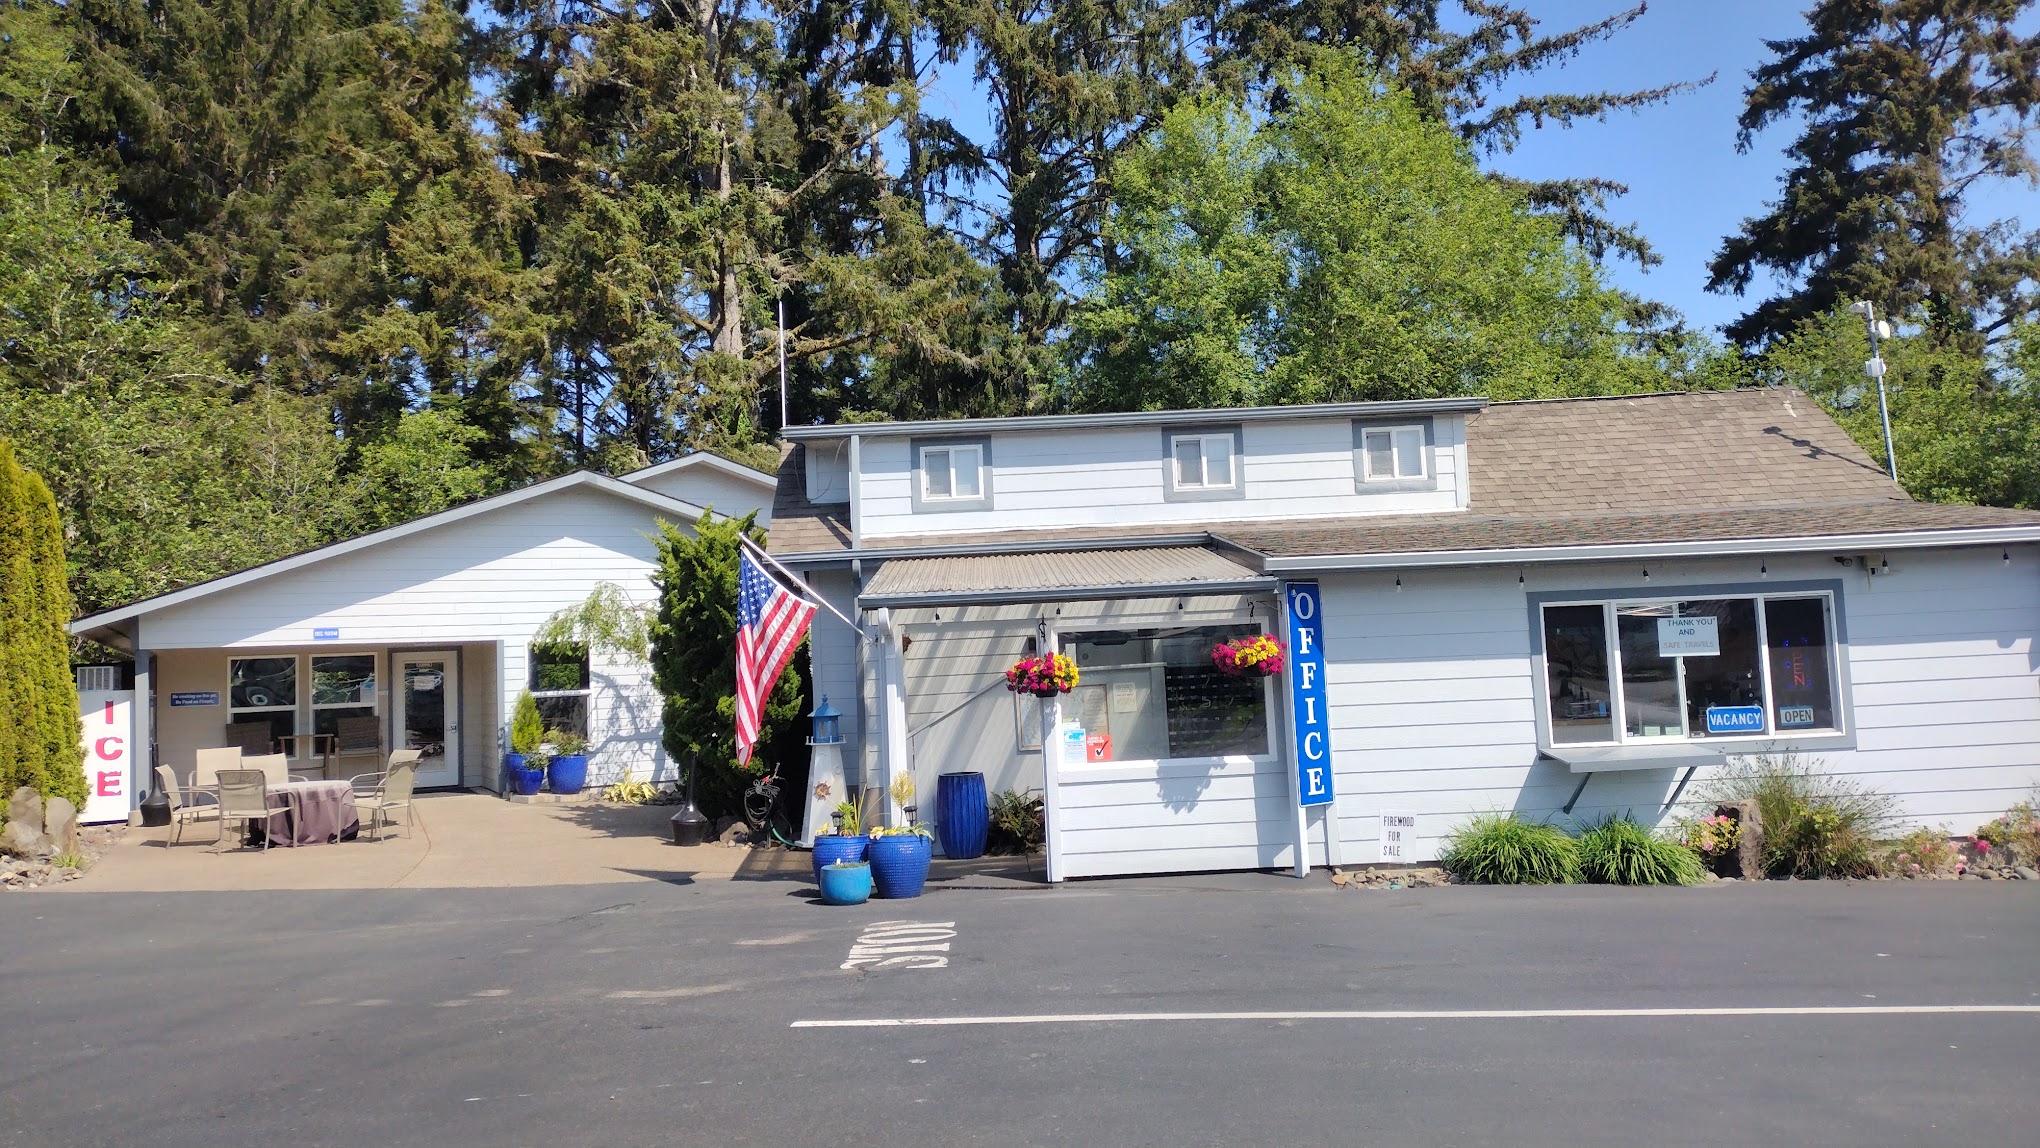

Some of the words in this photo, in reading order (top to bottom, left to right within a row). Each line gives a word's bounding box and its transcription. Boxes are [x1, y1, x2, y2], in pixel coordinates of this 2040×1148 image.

[1666, 619, 1695, 627] THANK
[1696, 618, 1713, 626] YOU
[1678, 628, 1696, 636] AND
[1663, 641, 1681, 649] SAFE
[1684, 640, 1715, 648] TRAVELS
[1294, 592, 1326, 796] OFFICE
[1709, 712, 1761, 726] VACANCY
[1784, 709, 1812, 723] OPEN
[95, 701, 123, 796] ICE
[1383, 815, 1415, 827] FIREWOOD
[1387, 830, 1401, 842] FOR
[1383, 845, 1401, 857] SALE
